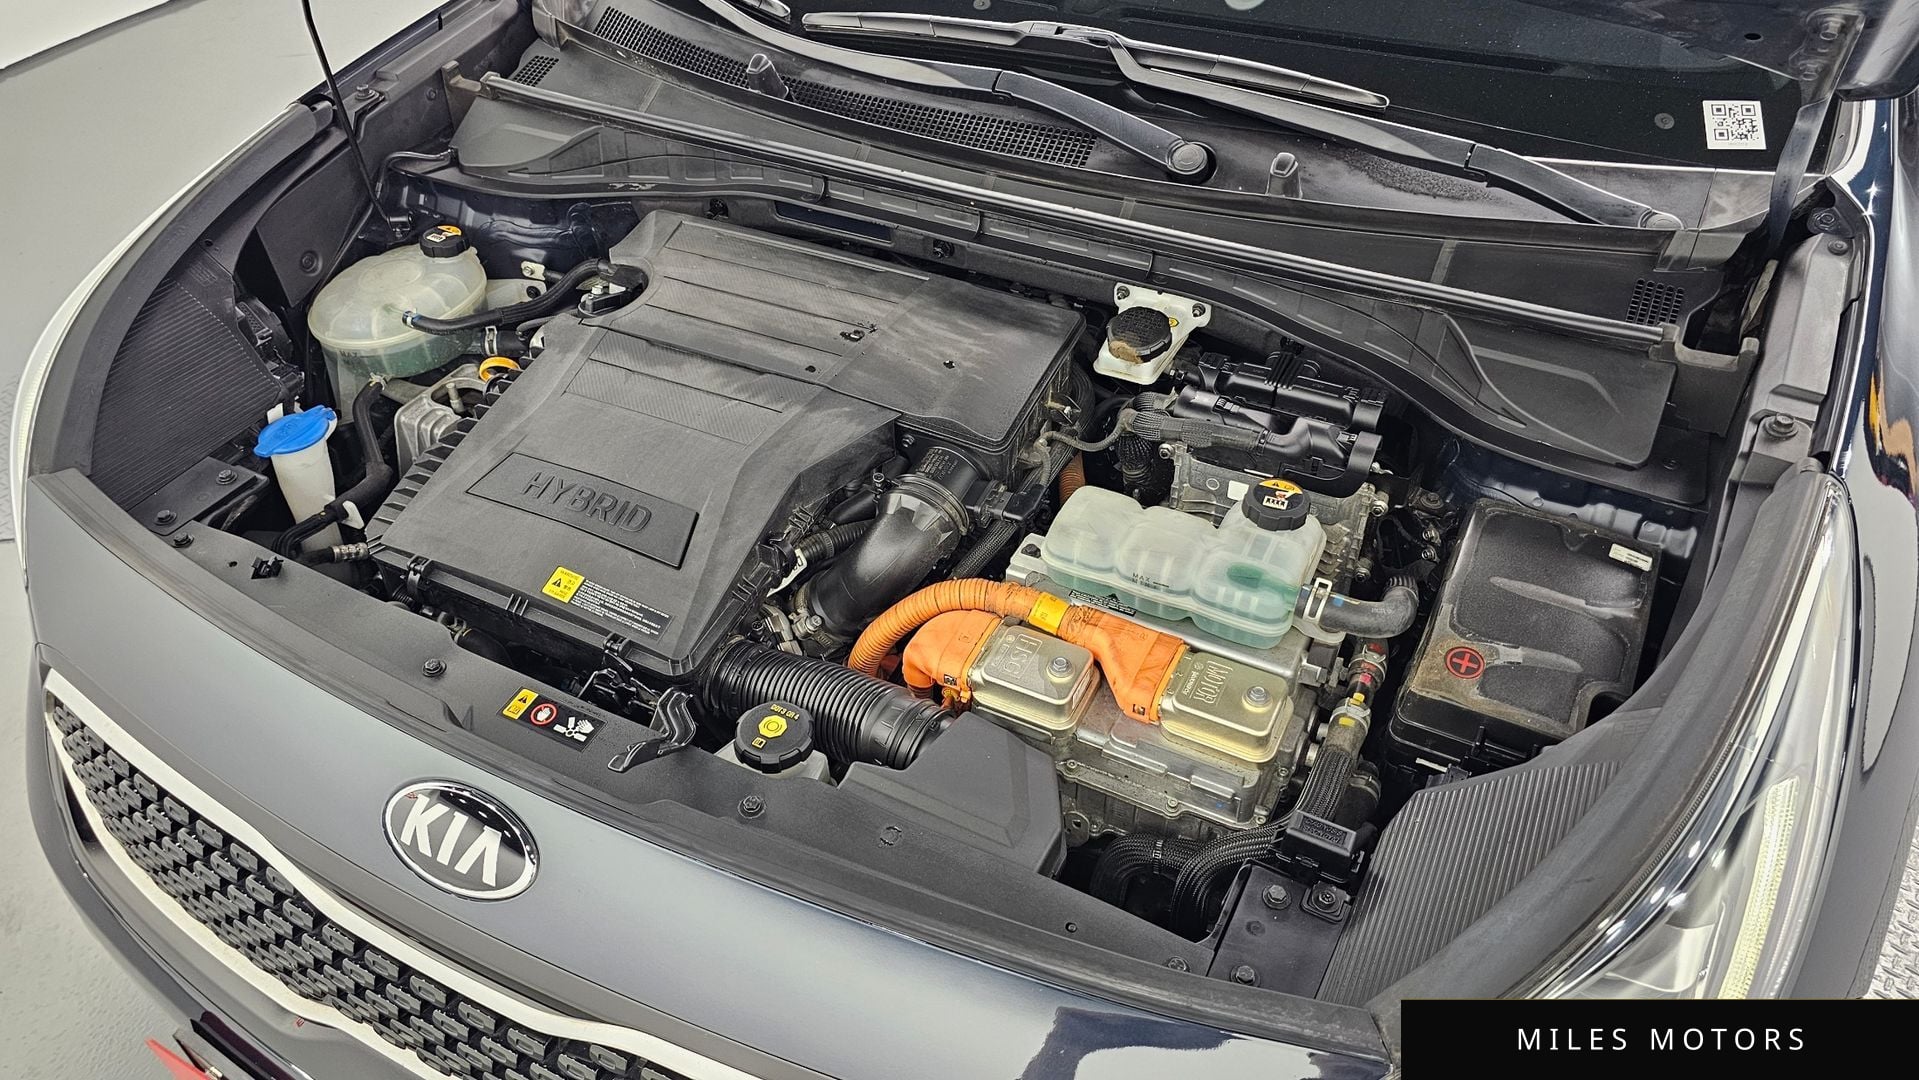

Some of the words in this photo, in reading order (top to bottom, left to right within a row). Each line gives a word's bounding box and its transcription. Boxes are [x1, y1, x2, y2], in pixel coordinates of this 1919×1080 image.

[520, 471, 652, 532] HYBRID
[1132, 572, 1151, 582] MAX
[1003, 638, 1038, 675] HSG
[1193, 665, 1229, 704] MOTOR
[400, 794, 502, 887] KIA
